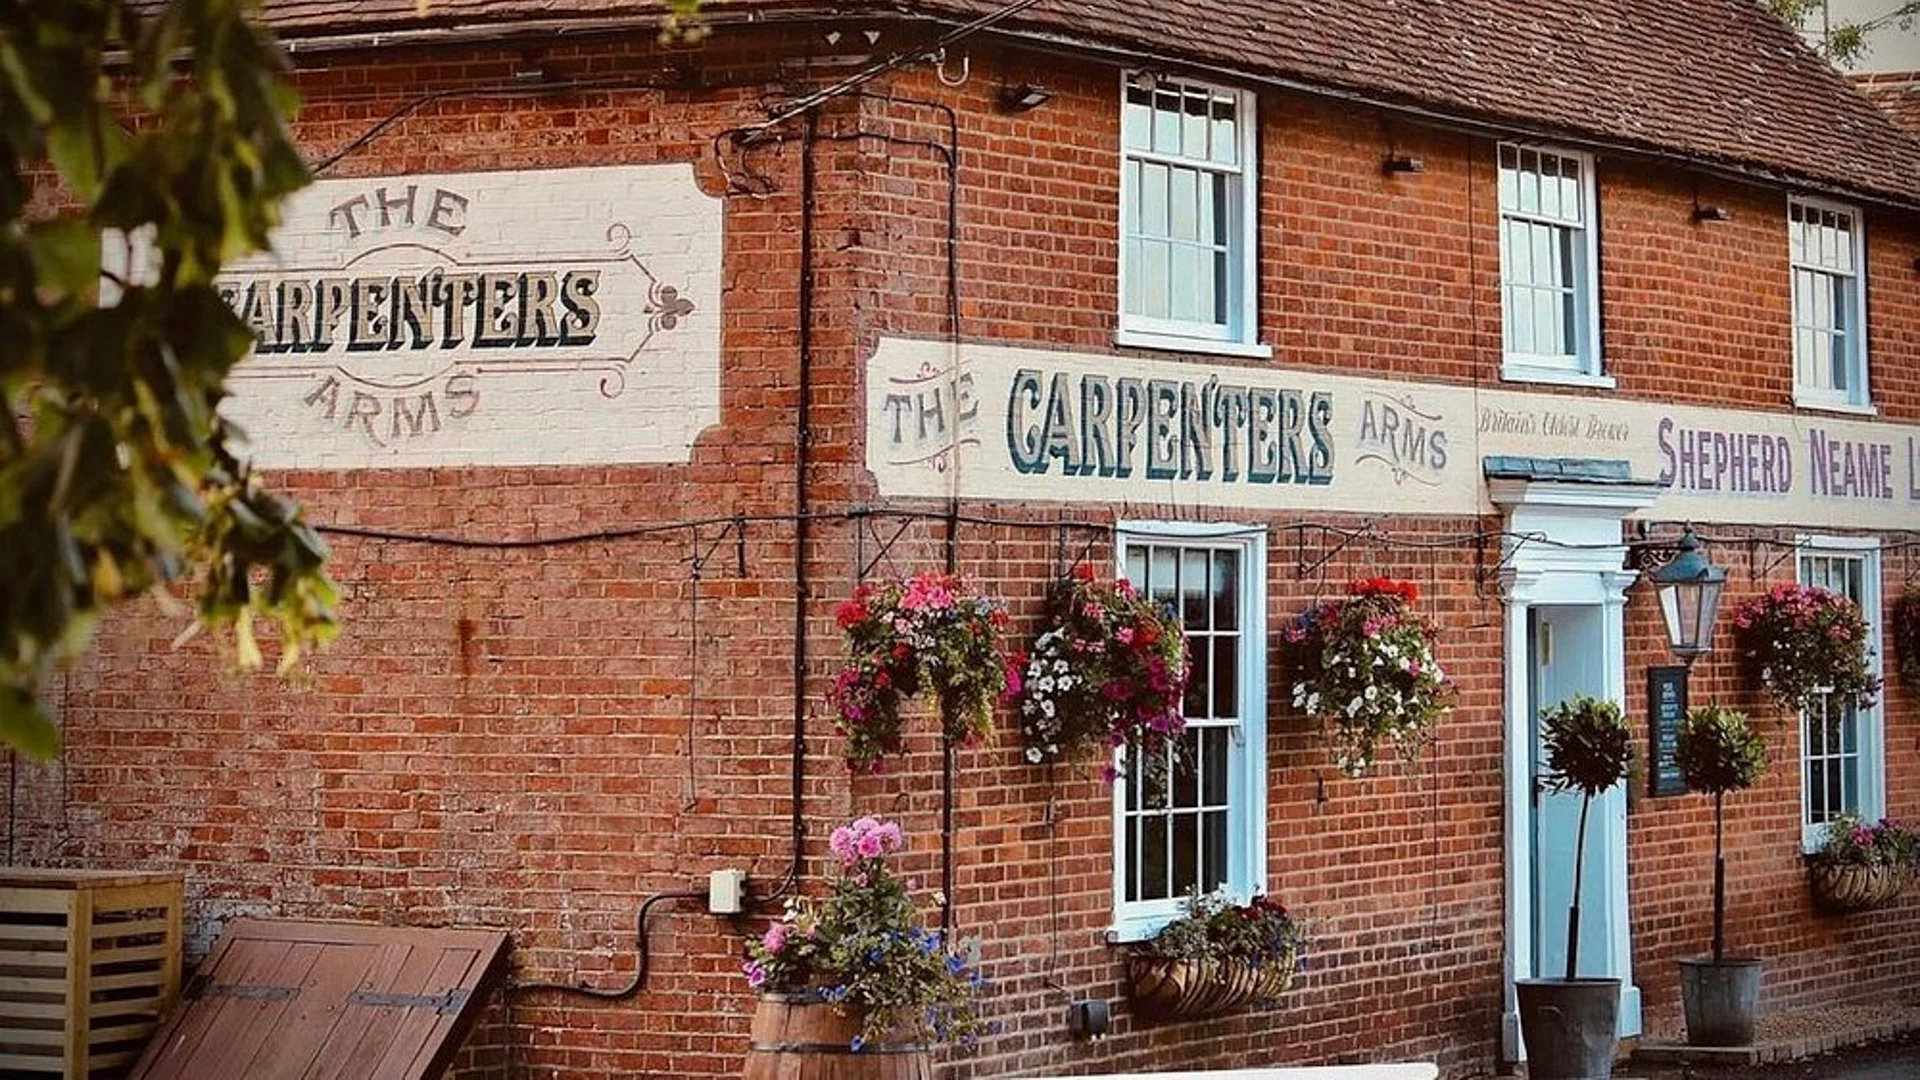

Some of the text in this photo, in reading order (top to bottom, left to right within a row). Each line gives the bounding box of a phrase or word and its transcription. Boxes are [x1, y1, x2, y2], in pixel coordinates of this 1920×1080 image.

[329, 185, 469, 238] THE
[304, 373, 481, 448] ARMS
[882, 368, 1448, 485] THE CARPENTERS ARMS
